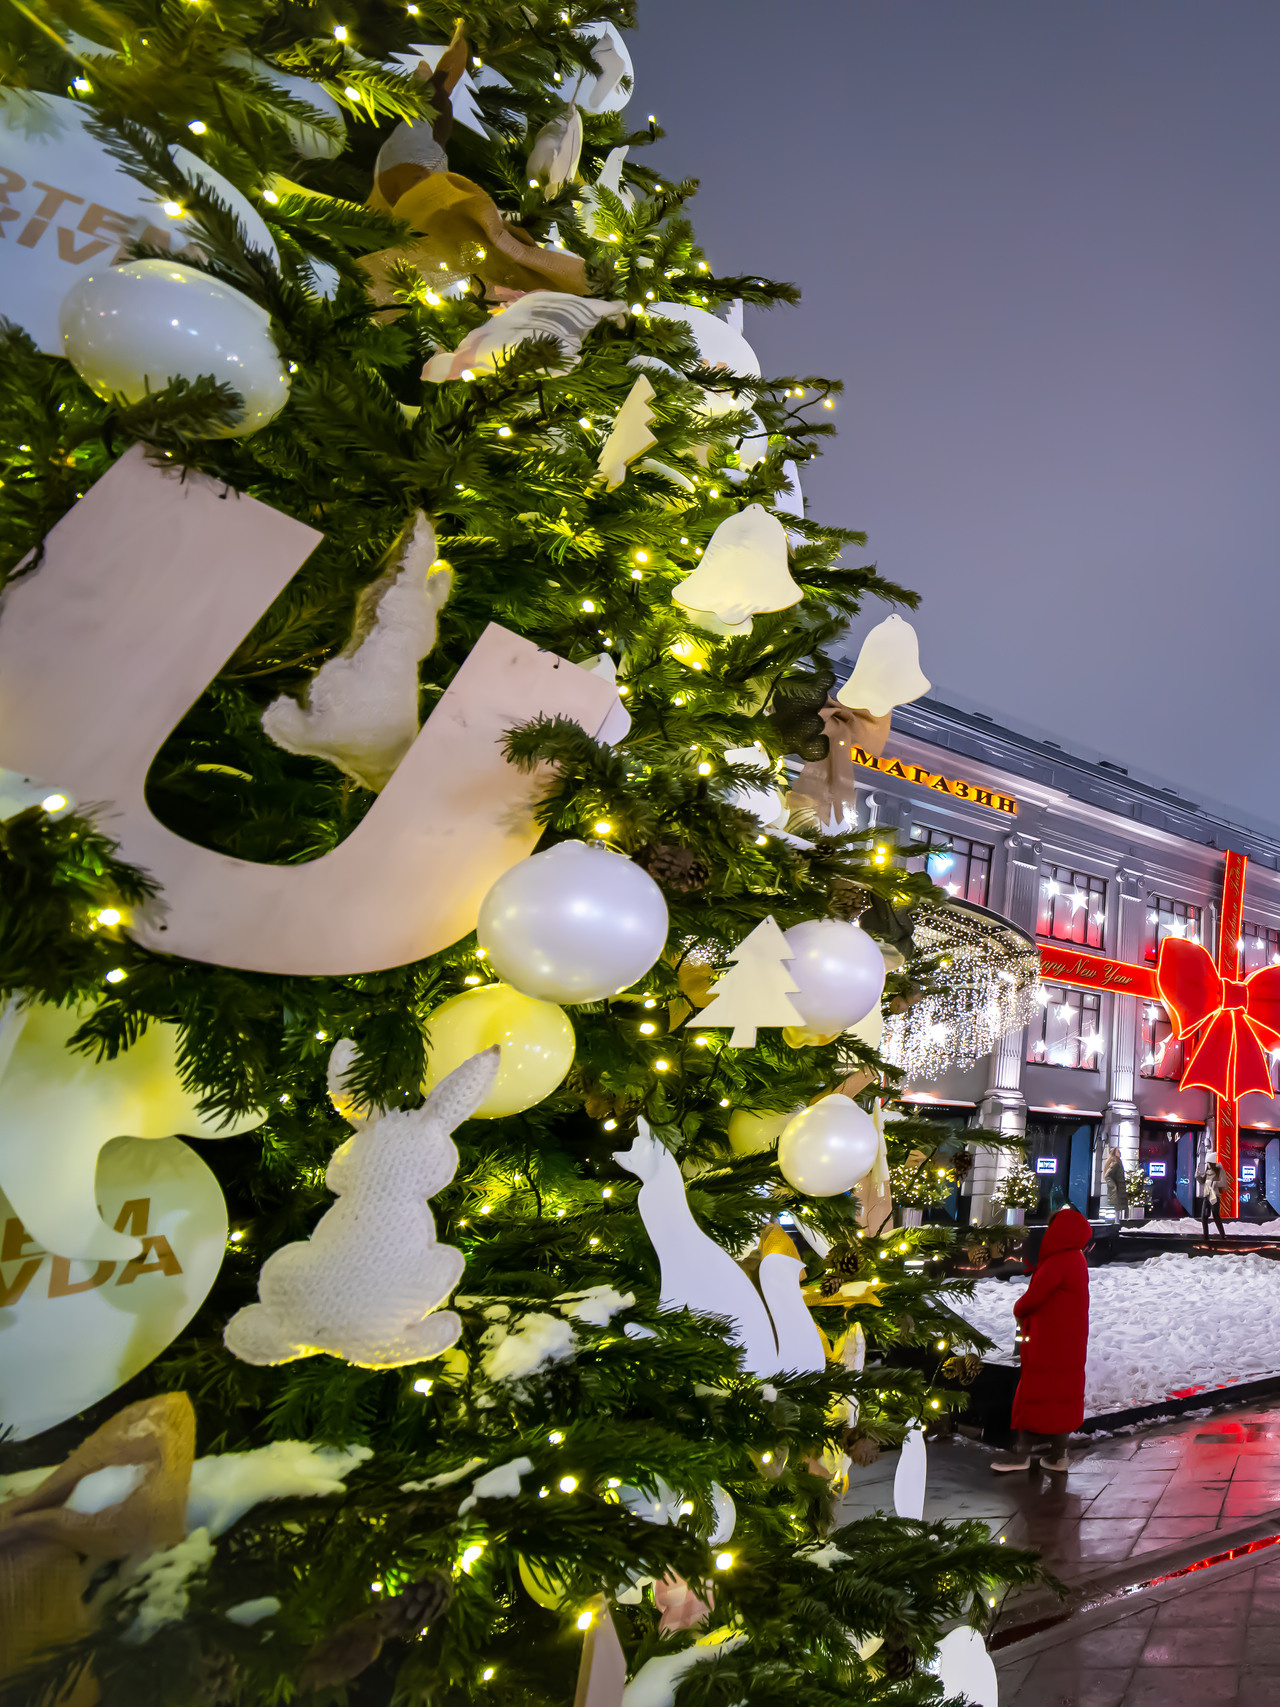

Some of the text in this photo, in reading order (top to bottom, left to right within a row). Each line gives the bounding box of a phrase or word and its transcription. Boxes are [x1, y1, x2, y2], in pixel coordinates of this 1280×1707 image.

[851, 745, 1017, 815] МАГАЗИН
[1067, 958, 1097, 979] New
[1101, 963, 1134, 986] Year
